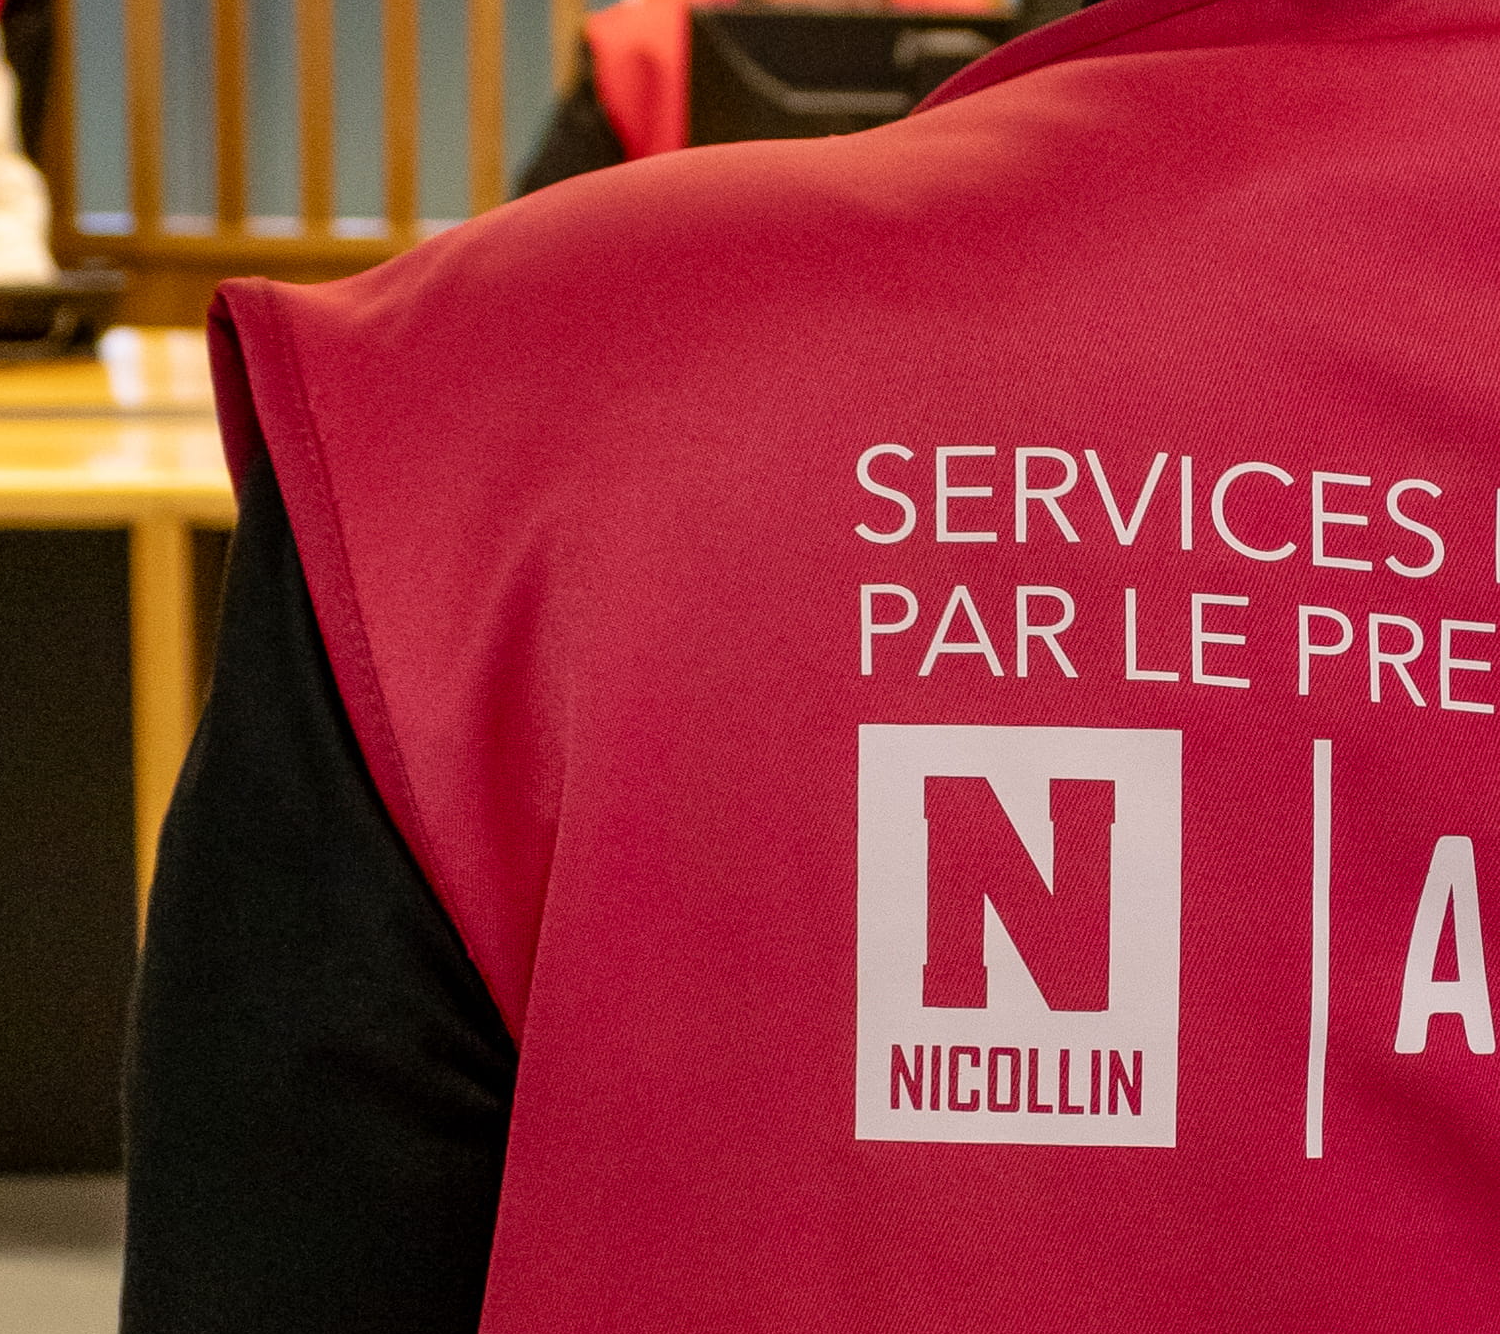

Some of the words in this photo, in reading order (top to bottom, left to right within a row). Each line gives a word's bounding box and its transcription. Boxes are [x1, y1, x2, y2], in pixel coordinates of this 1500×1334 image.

[854, 442, 1445, 578] SERVICES
[860, 583, 1078, 678] PAR
[1124, 586, 1251, 689] LE
[921, 775, 1117, 1013] N
[889, 1043, 1144, 1116] NICOLLIN
